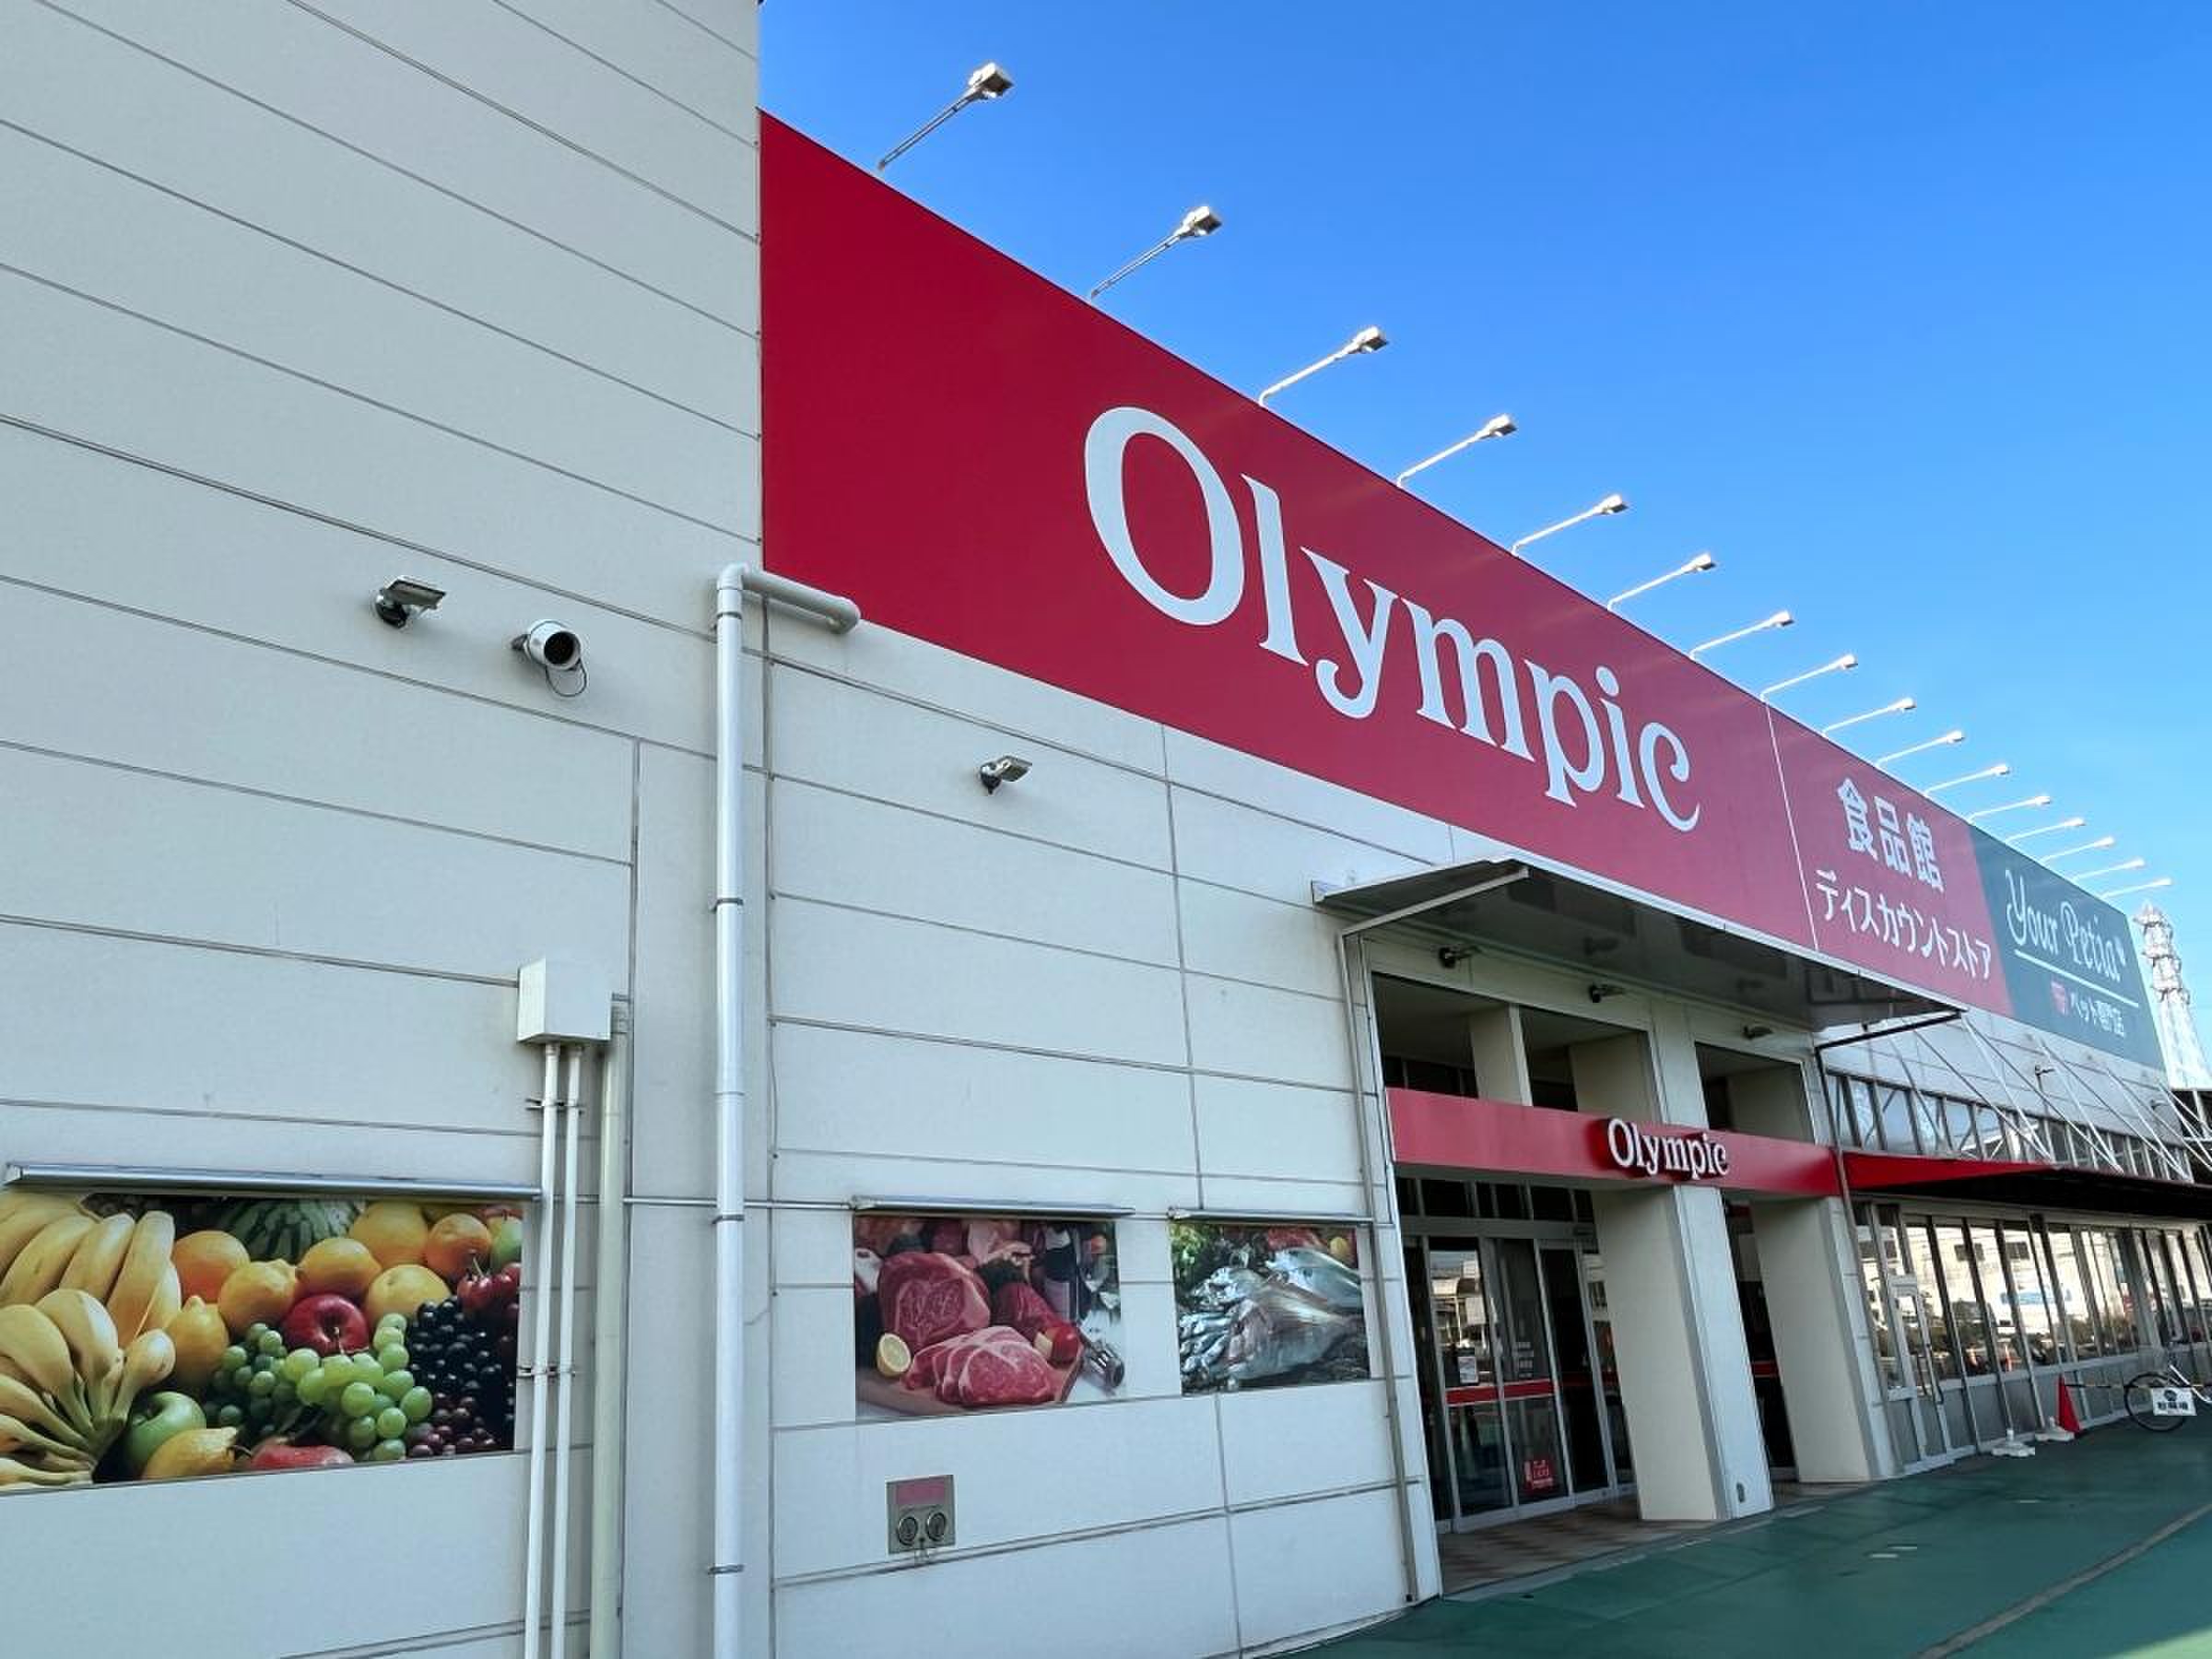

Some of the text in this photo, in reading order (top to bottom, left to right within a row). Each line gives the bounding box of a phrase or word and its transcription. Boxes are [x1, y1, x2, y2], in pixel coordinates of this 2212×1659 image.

[1085, 406, 1700, 831] Olympic
[1837, 778, 1945, 893] 食品館
[1816, 869, 1992, 980] ディスカウントストア
[2005, 869, 2059, 955] Your
[1607, 1118, 1730, 1181] Olympic
